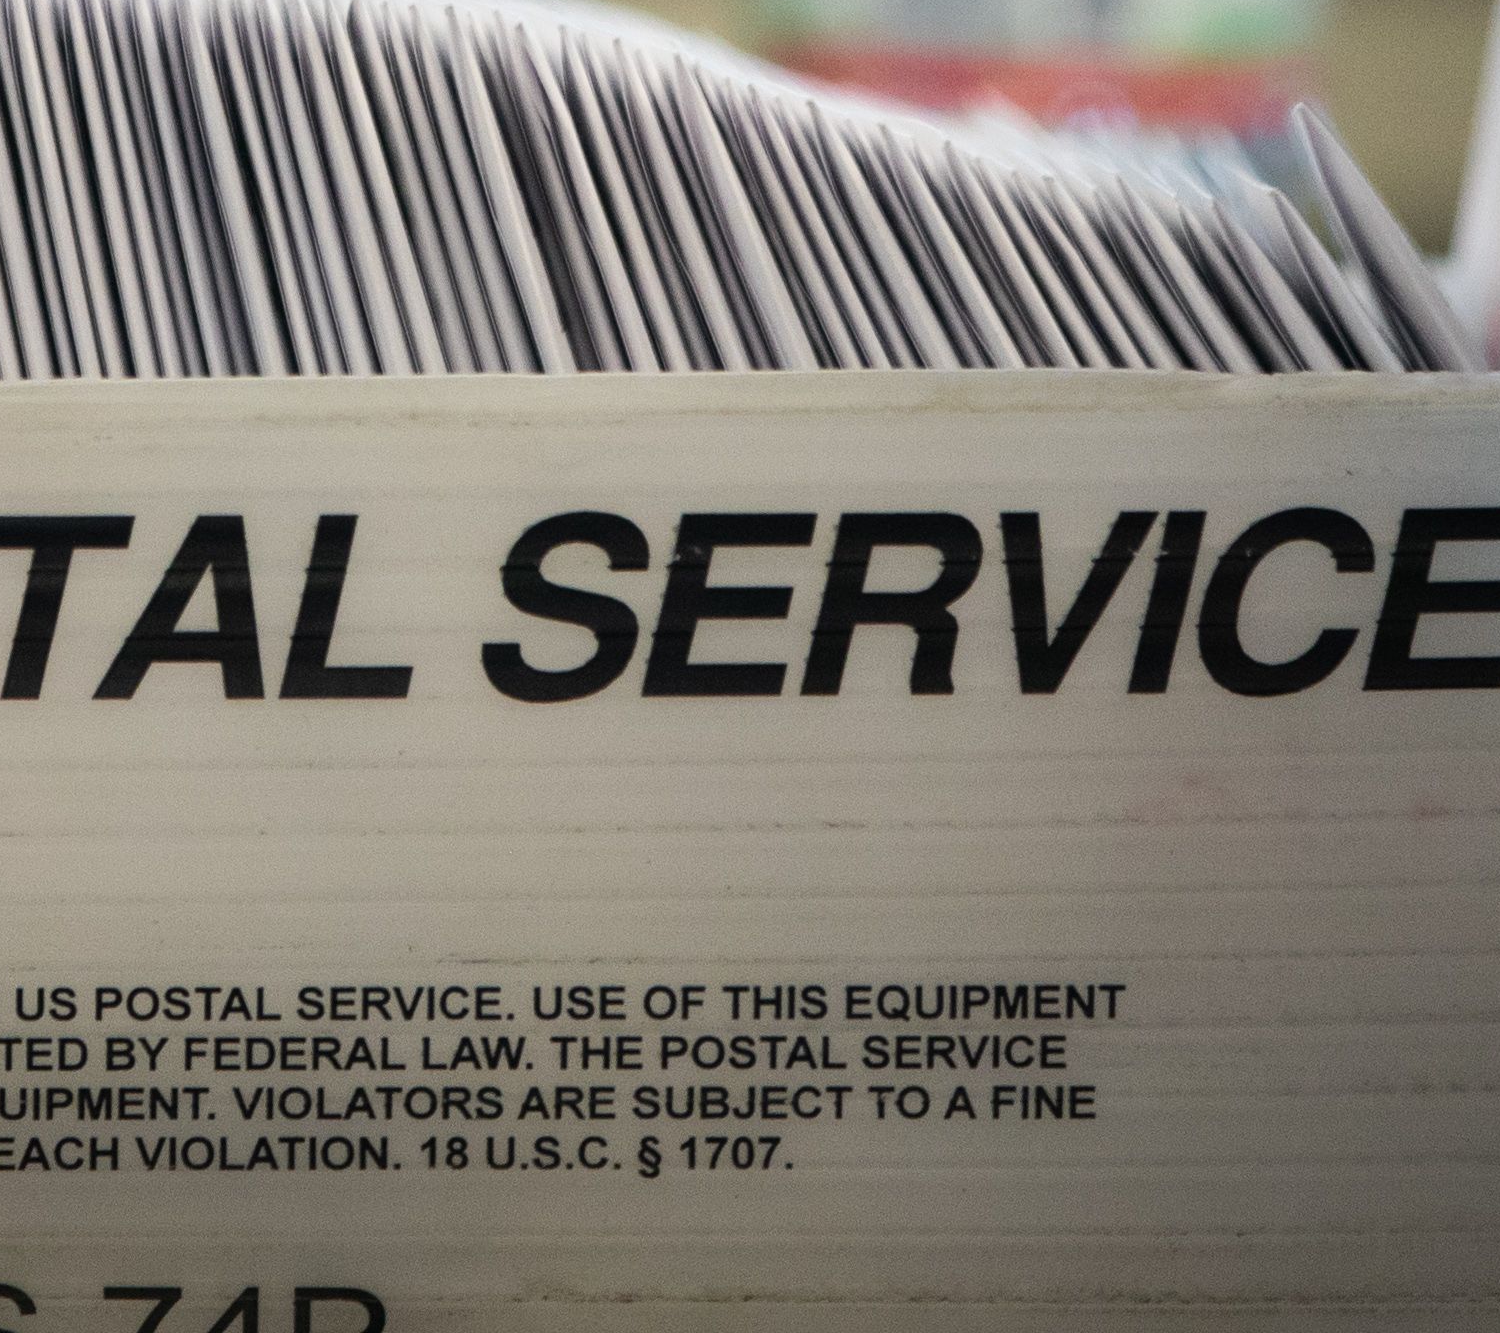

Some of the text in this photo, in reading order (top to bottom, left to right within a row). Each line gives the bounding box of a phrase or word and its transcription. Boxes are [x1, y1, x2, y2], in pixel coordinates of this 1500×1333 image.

[15, 987, 77, 1022] US
[95, 986, 282, 1022] POSTAL
[296, 985, 517, 1021] SERVICE.
[533, 985, 627, 1021] USE
[643, 985, 706, 1021] OF
[722, 984, 828, 1021] THIS
[845, 983, 1127, 1022] EQUIPMENT
[105, 1037, 168, 1072] BY
[184, 1036, 406, 1071] FEDERAL
[422, 1036, 536, 1071] LAW.
[550, 1035, 643, 1070] THE
[660, 1035, 847, 1070] POSTAL
[862, 1034, 1067, 1070] SERVICE
[232, 1086, 504, 1121] VIOLATORS
[517, 1086, 616, 1120] ARE
[632, 1085, 853, 1120] SUBJECT
[867, 1085, 931, 1120] TO
[944, 1085, 977, 1120] A
[990, 1085, 1096, 1120] FINE
[136, 1135, 401, 1171] VIOLATION.
[420, 1136, 469, 1170] 18
[486, 1135, 622, 1171] U.S.C.
[637, 1135, 662, 1179] §
[680, 1135, 794, 1171] 1707.
